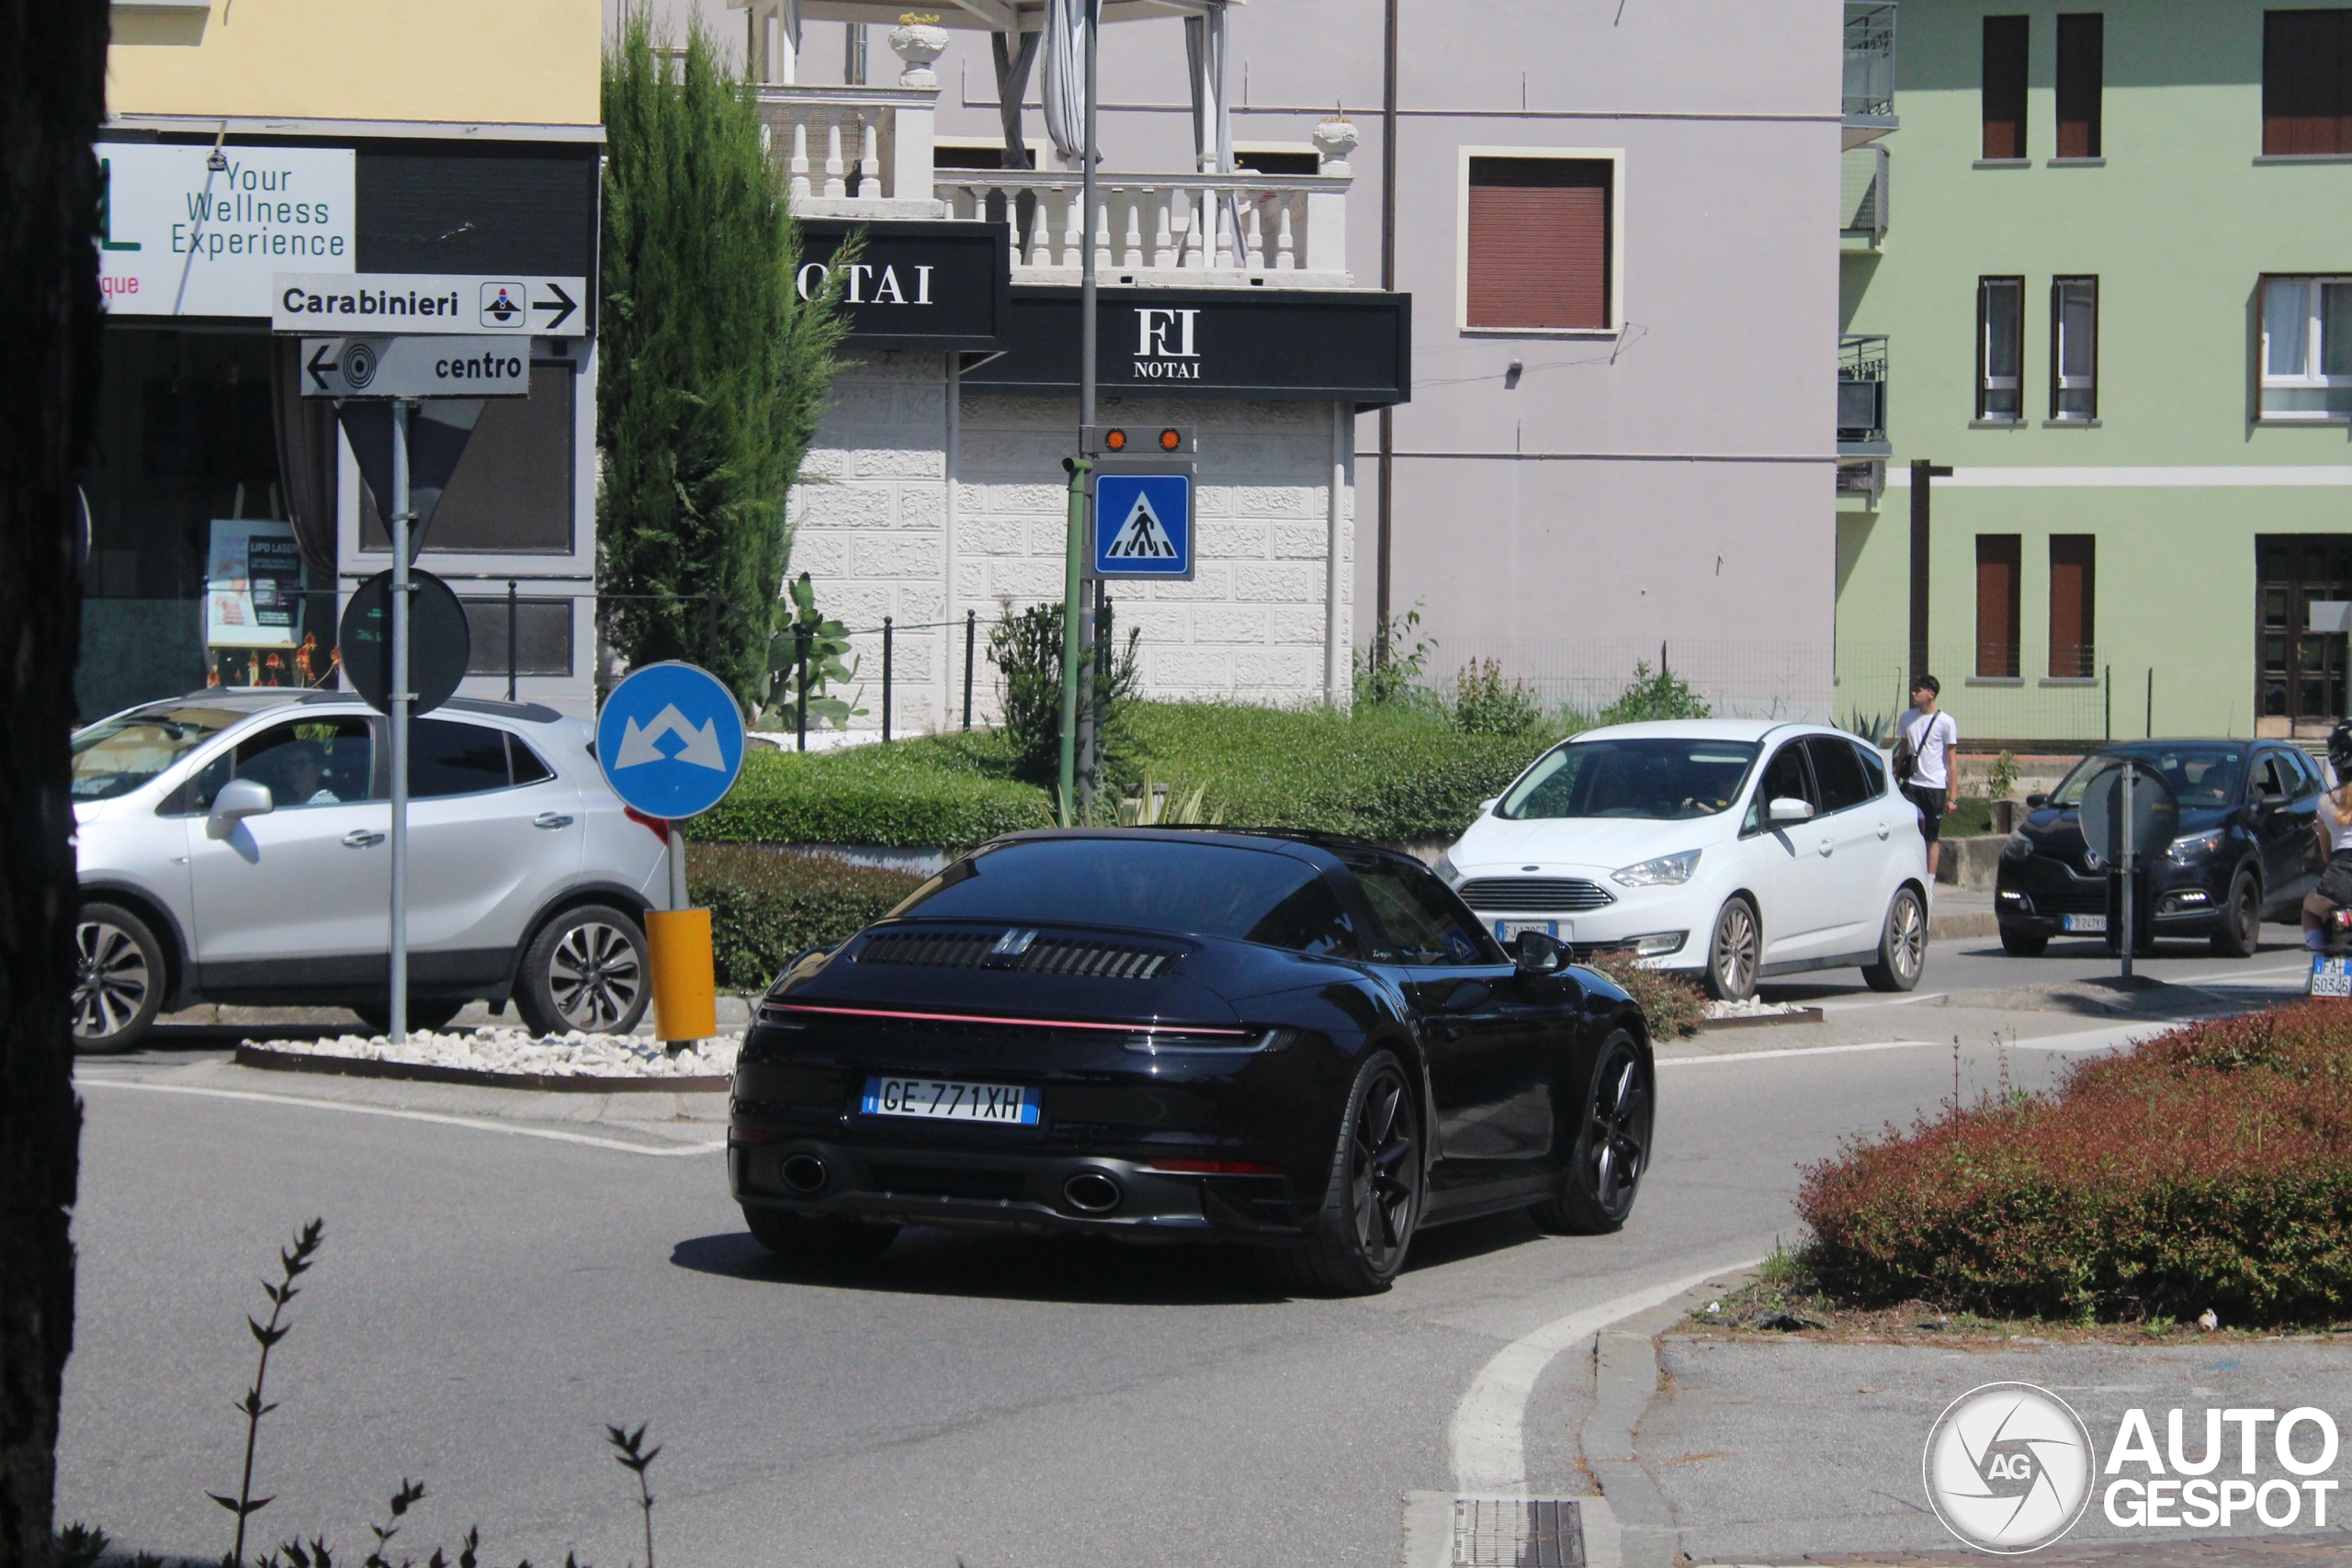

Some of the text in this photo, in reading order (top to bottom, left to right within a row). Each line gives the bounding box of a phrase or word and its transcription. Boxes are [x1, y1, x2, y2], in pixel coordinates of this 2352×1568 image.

[225, 161, 292, 191] Your
[187, 192, 329, 224] Wellness
[172, 223, 345, 262] Experience
[797, 262, 934, 305] OTAI
[282, 288, 458, 317] Carabinieri
[435, 352, 522, 379] centro
[1133, 361, 1201, 379] NOTAI
[250, 542, 270, 553] LIPO
[884, 1080, 919, 1112] GE
[928, 1083, 1020, 1120] 771XH
